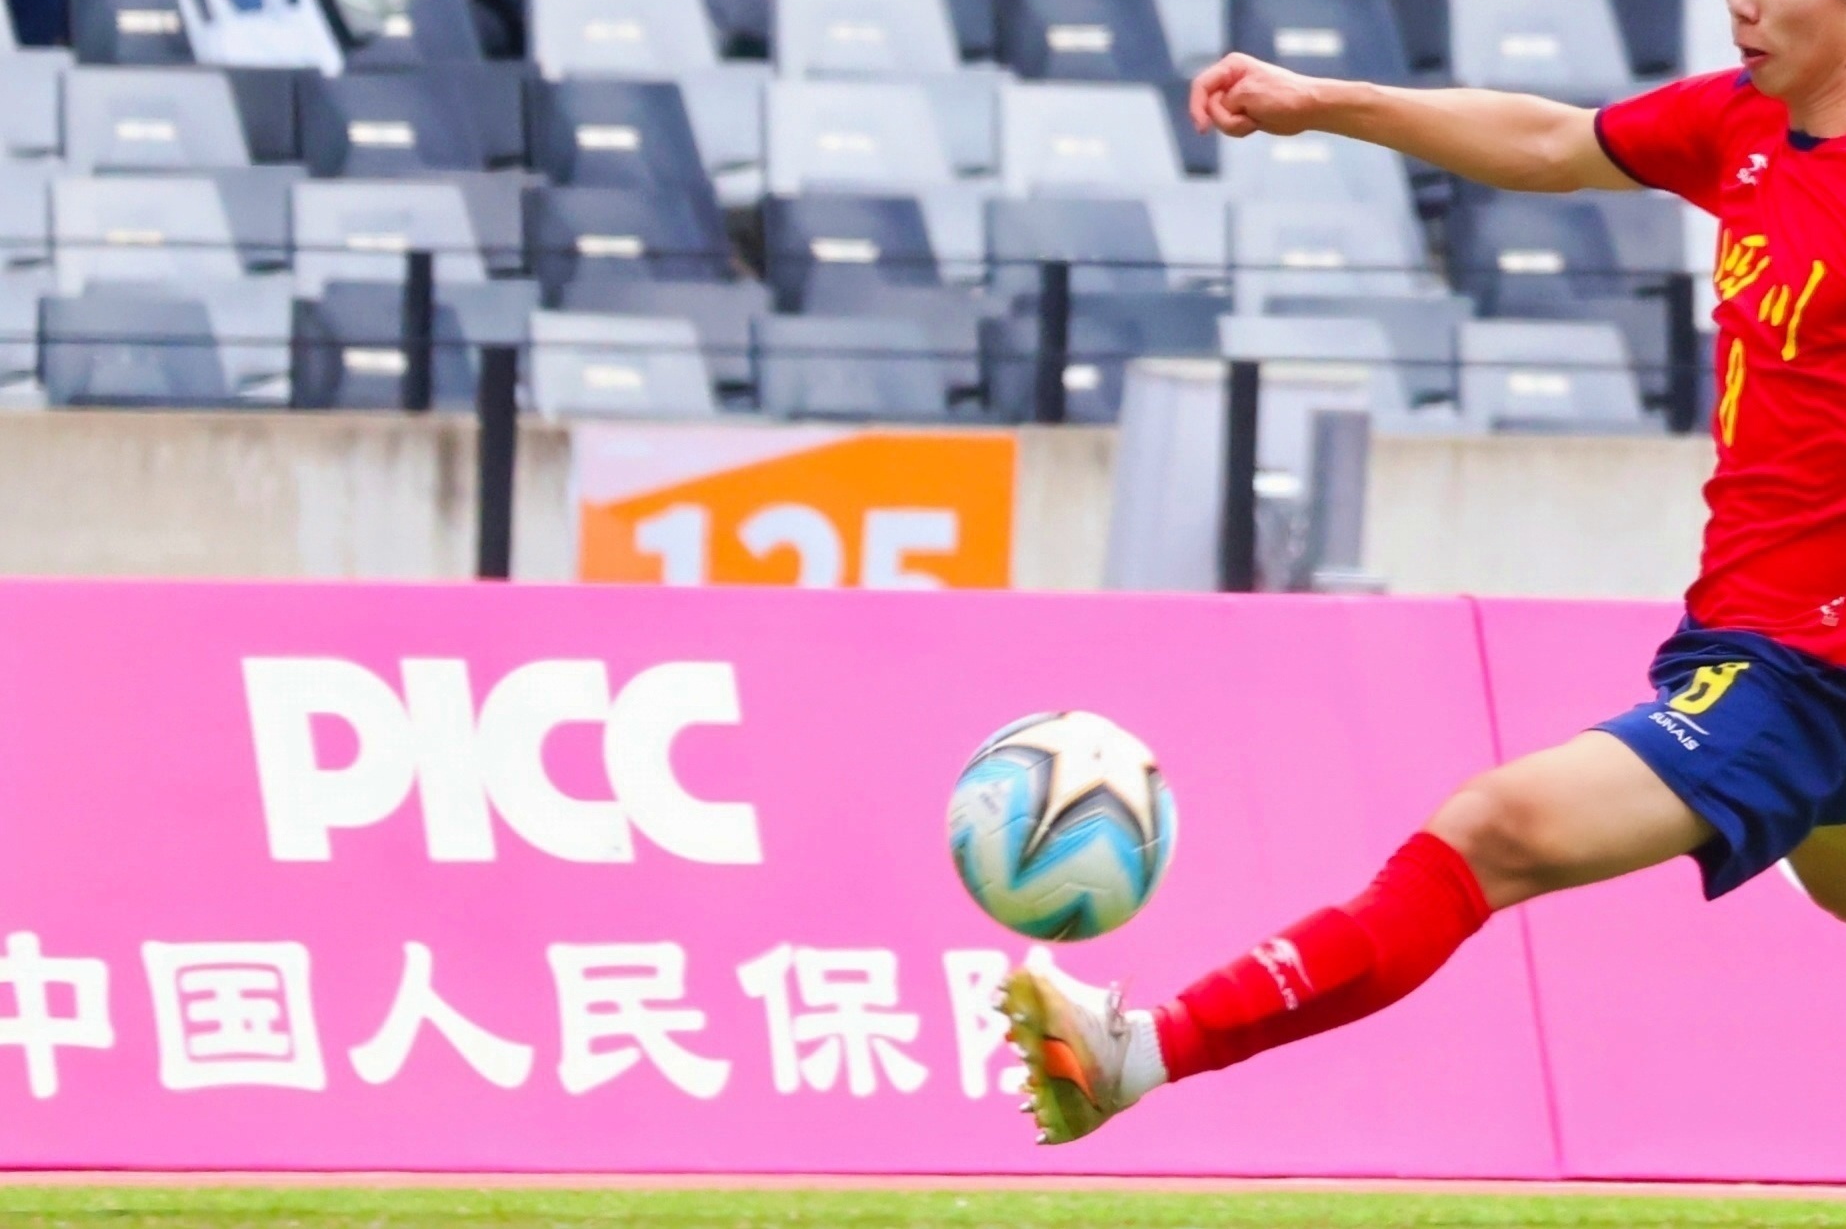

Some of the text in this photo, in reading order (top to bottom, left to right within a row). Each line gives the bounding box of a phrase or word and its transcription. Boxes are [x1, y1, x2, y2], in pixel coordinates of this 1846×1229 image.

[1718, 337, 1745, 449] 8
[240, 656, 764, 865] PICC
[1647, 711, 1700, 751] SUNAIS
